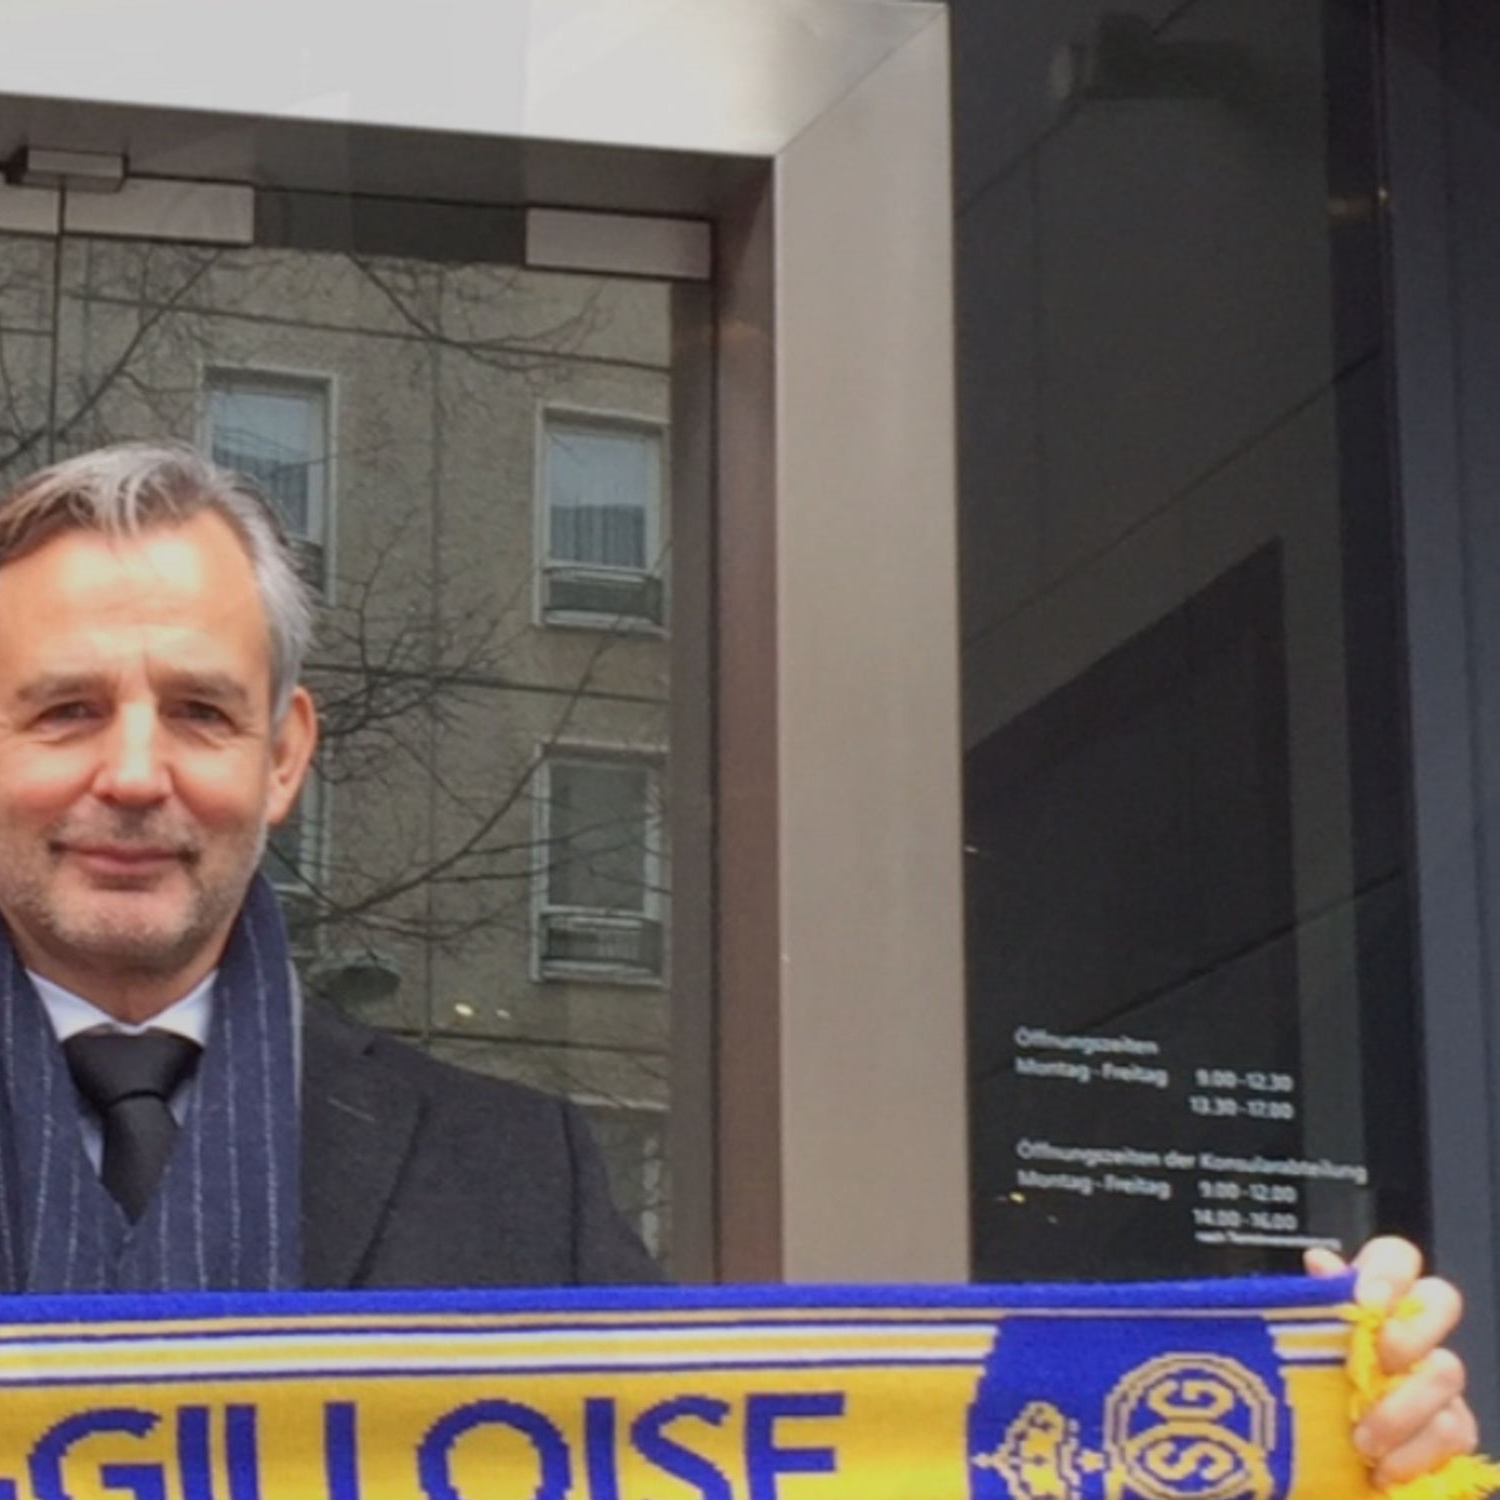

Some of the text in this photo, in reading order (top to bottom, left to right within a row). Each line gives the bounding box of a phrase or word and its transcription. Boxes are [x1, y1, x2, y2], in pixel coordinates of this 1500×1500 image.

[1014, 1026, 1159, 1056] Öffnungszeiten
[1015, 1056, 1090, 1083] Montag
[1102, 1061, 1169, 1089] Freitag
[1016, 1138, 1160, 1167] Öffnungszeiten
[1164, 1150, 1195, 1168] der
[1017, 1170, 1092, 1195] Montag
[1104, 1173, 1171, 1200] Freitag
